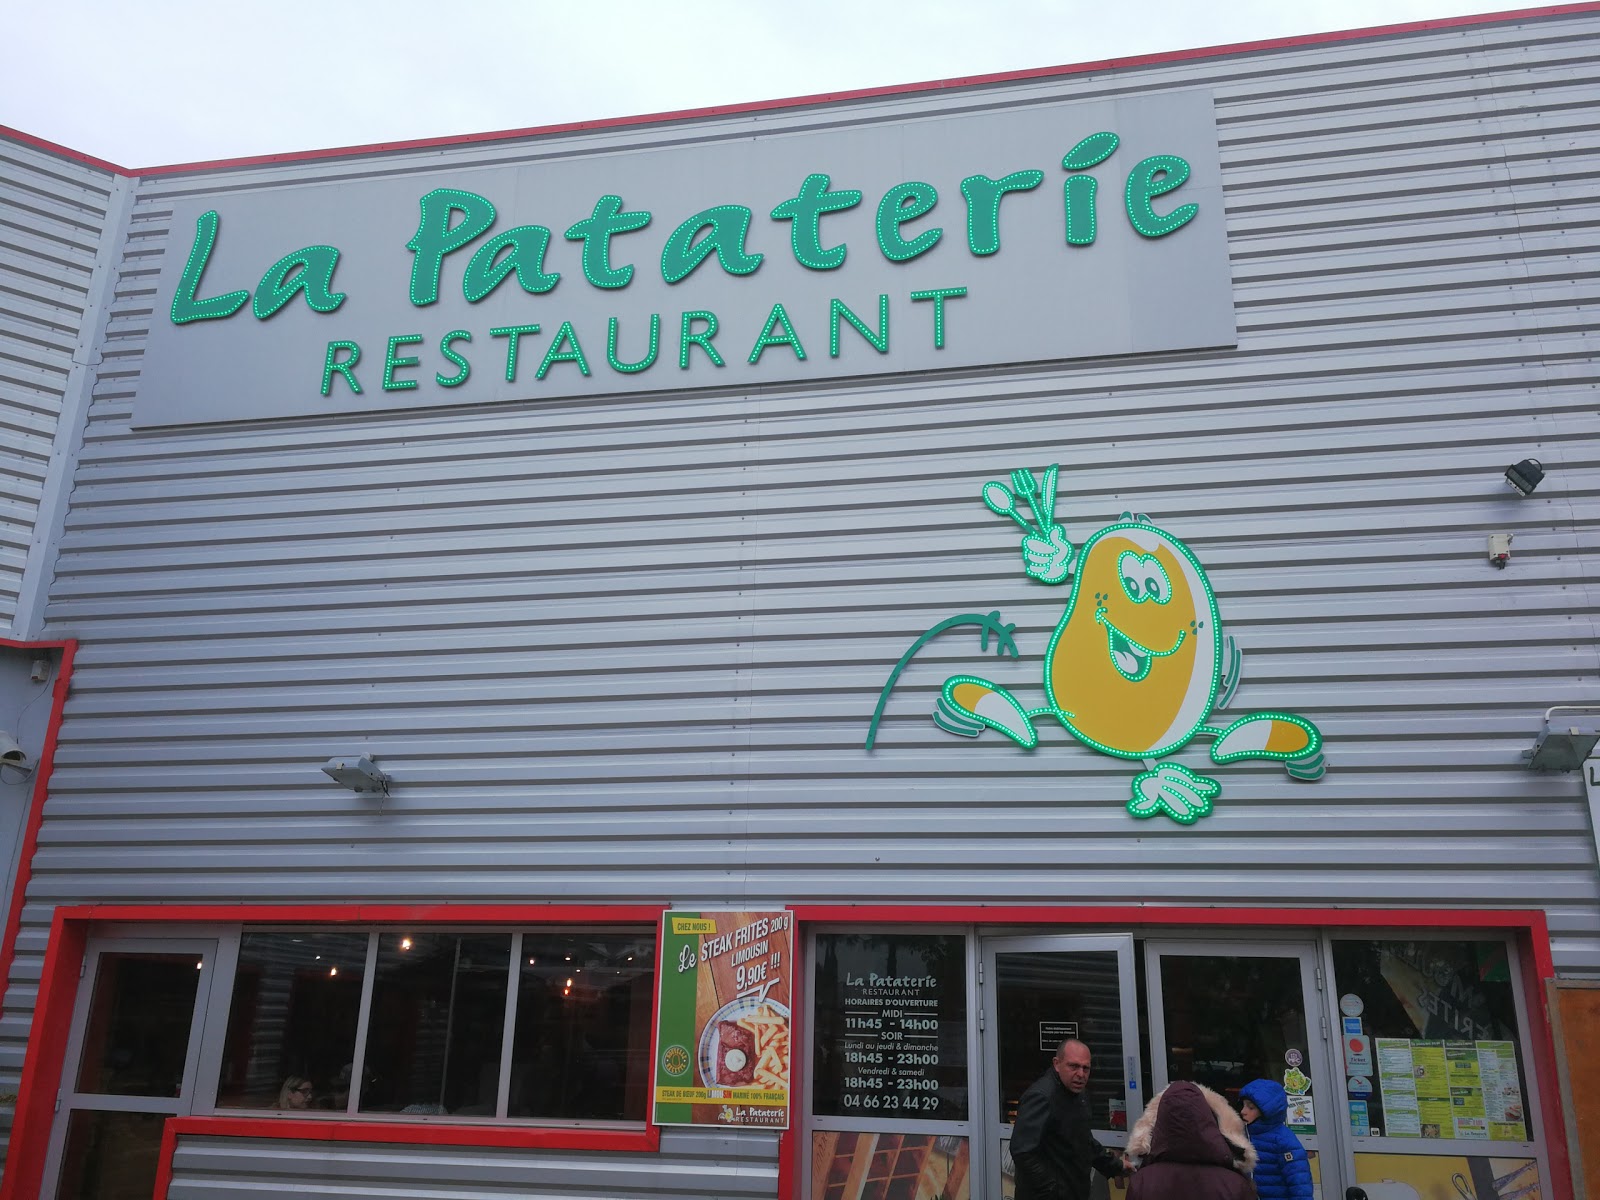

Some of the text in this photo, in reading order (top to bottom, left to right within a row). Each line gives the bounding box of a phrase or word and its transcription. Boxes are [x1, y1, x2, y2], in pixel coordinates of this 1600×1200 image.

[170, 131, 1200, 325] La Pataterie
[320, 286, 968, 397] RESTAURANT
[677, 922, 691, 931] CHEZ
[692, 922, 707, 931] NOUS
[678, 916, 789, 973] Le STEAK FRITES 200 g
[731, 940, 769, 967] LIMOUSIN
[736, 961, 768, 991] 9,90€
[846, 972, 937, 988] La Pataterie
[862, 988, 920, 996] RESTAURANT
[845, 998, 938, 1007] HORAIRES D'OUVERTURE
[881, 1009, 903, 1018] MIDI
[845, 1018, 882, 1029] 11h45
[900, 1019, 939, 1030] 14h00
[881, 1031, 903, 1040] SOIR
[876, 1042, 894, 1051] jeudi
[903, 1043, 939, 1052] dimanche
[844, 1052, 883, 1064] 18h45
[896, 1053, 939, 1065] 23h00
[857, 1067, 890, 1075] Vendredi
[844, 1077, 883, 1089] 18h45
[896, 1078, 939, 1090] 23h00
[662, 1090, 675, 1098] STEAK
[843, 1094, 939, 1110] 04 66 23 44 29
[736, 1107, 785, 1117] La Pataterie
